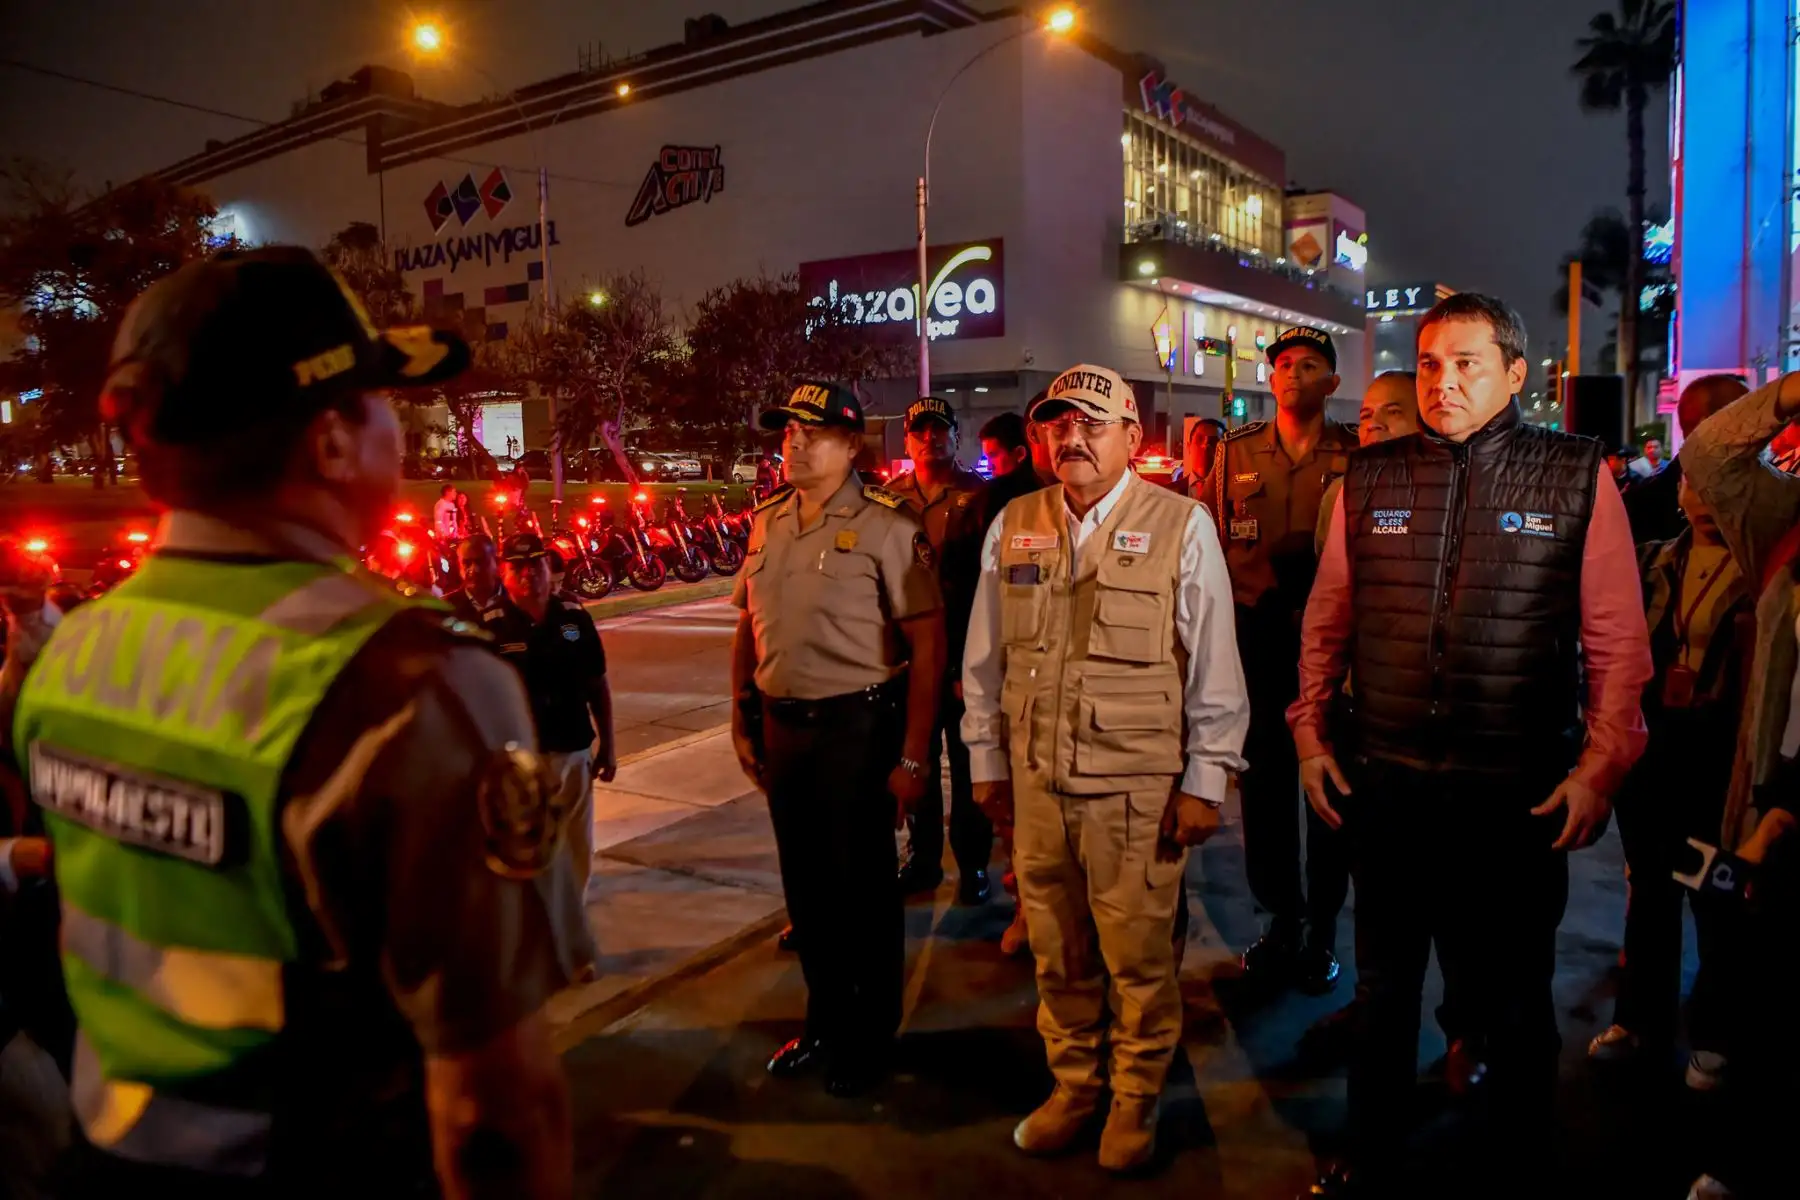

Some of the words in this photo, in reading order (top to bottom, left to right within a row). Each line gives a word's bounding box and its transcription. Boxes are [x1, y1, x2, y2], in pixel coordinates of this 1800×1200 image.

[446, 235, 482, 273] SAN
[484, 221, 560, 268] MIGUL
[1366, 287, 1421, 308] LEY
[1373, 510, 1412, 518] EDUARDO
[1372, 525, 1408, 534] ALCALDE
[1524, 522, 1553, 532] Miguel
